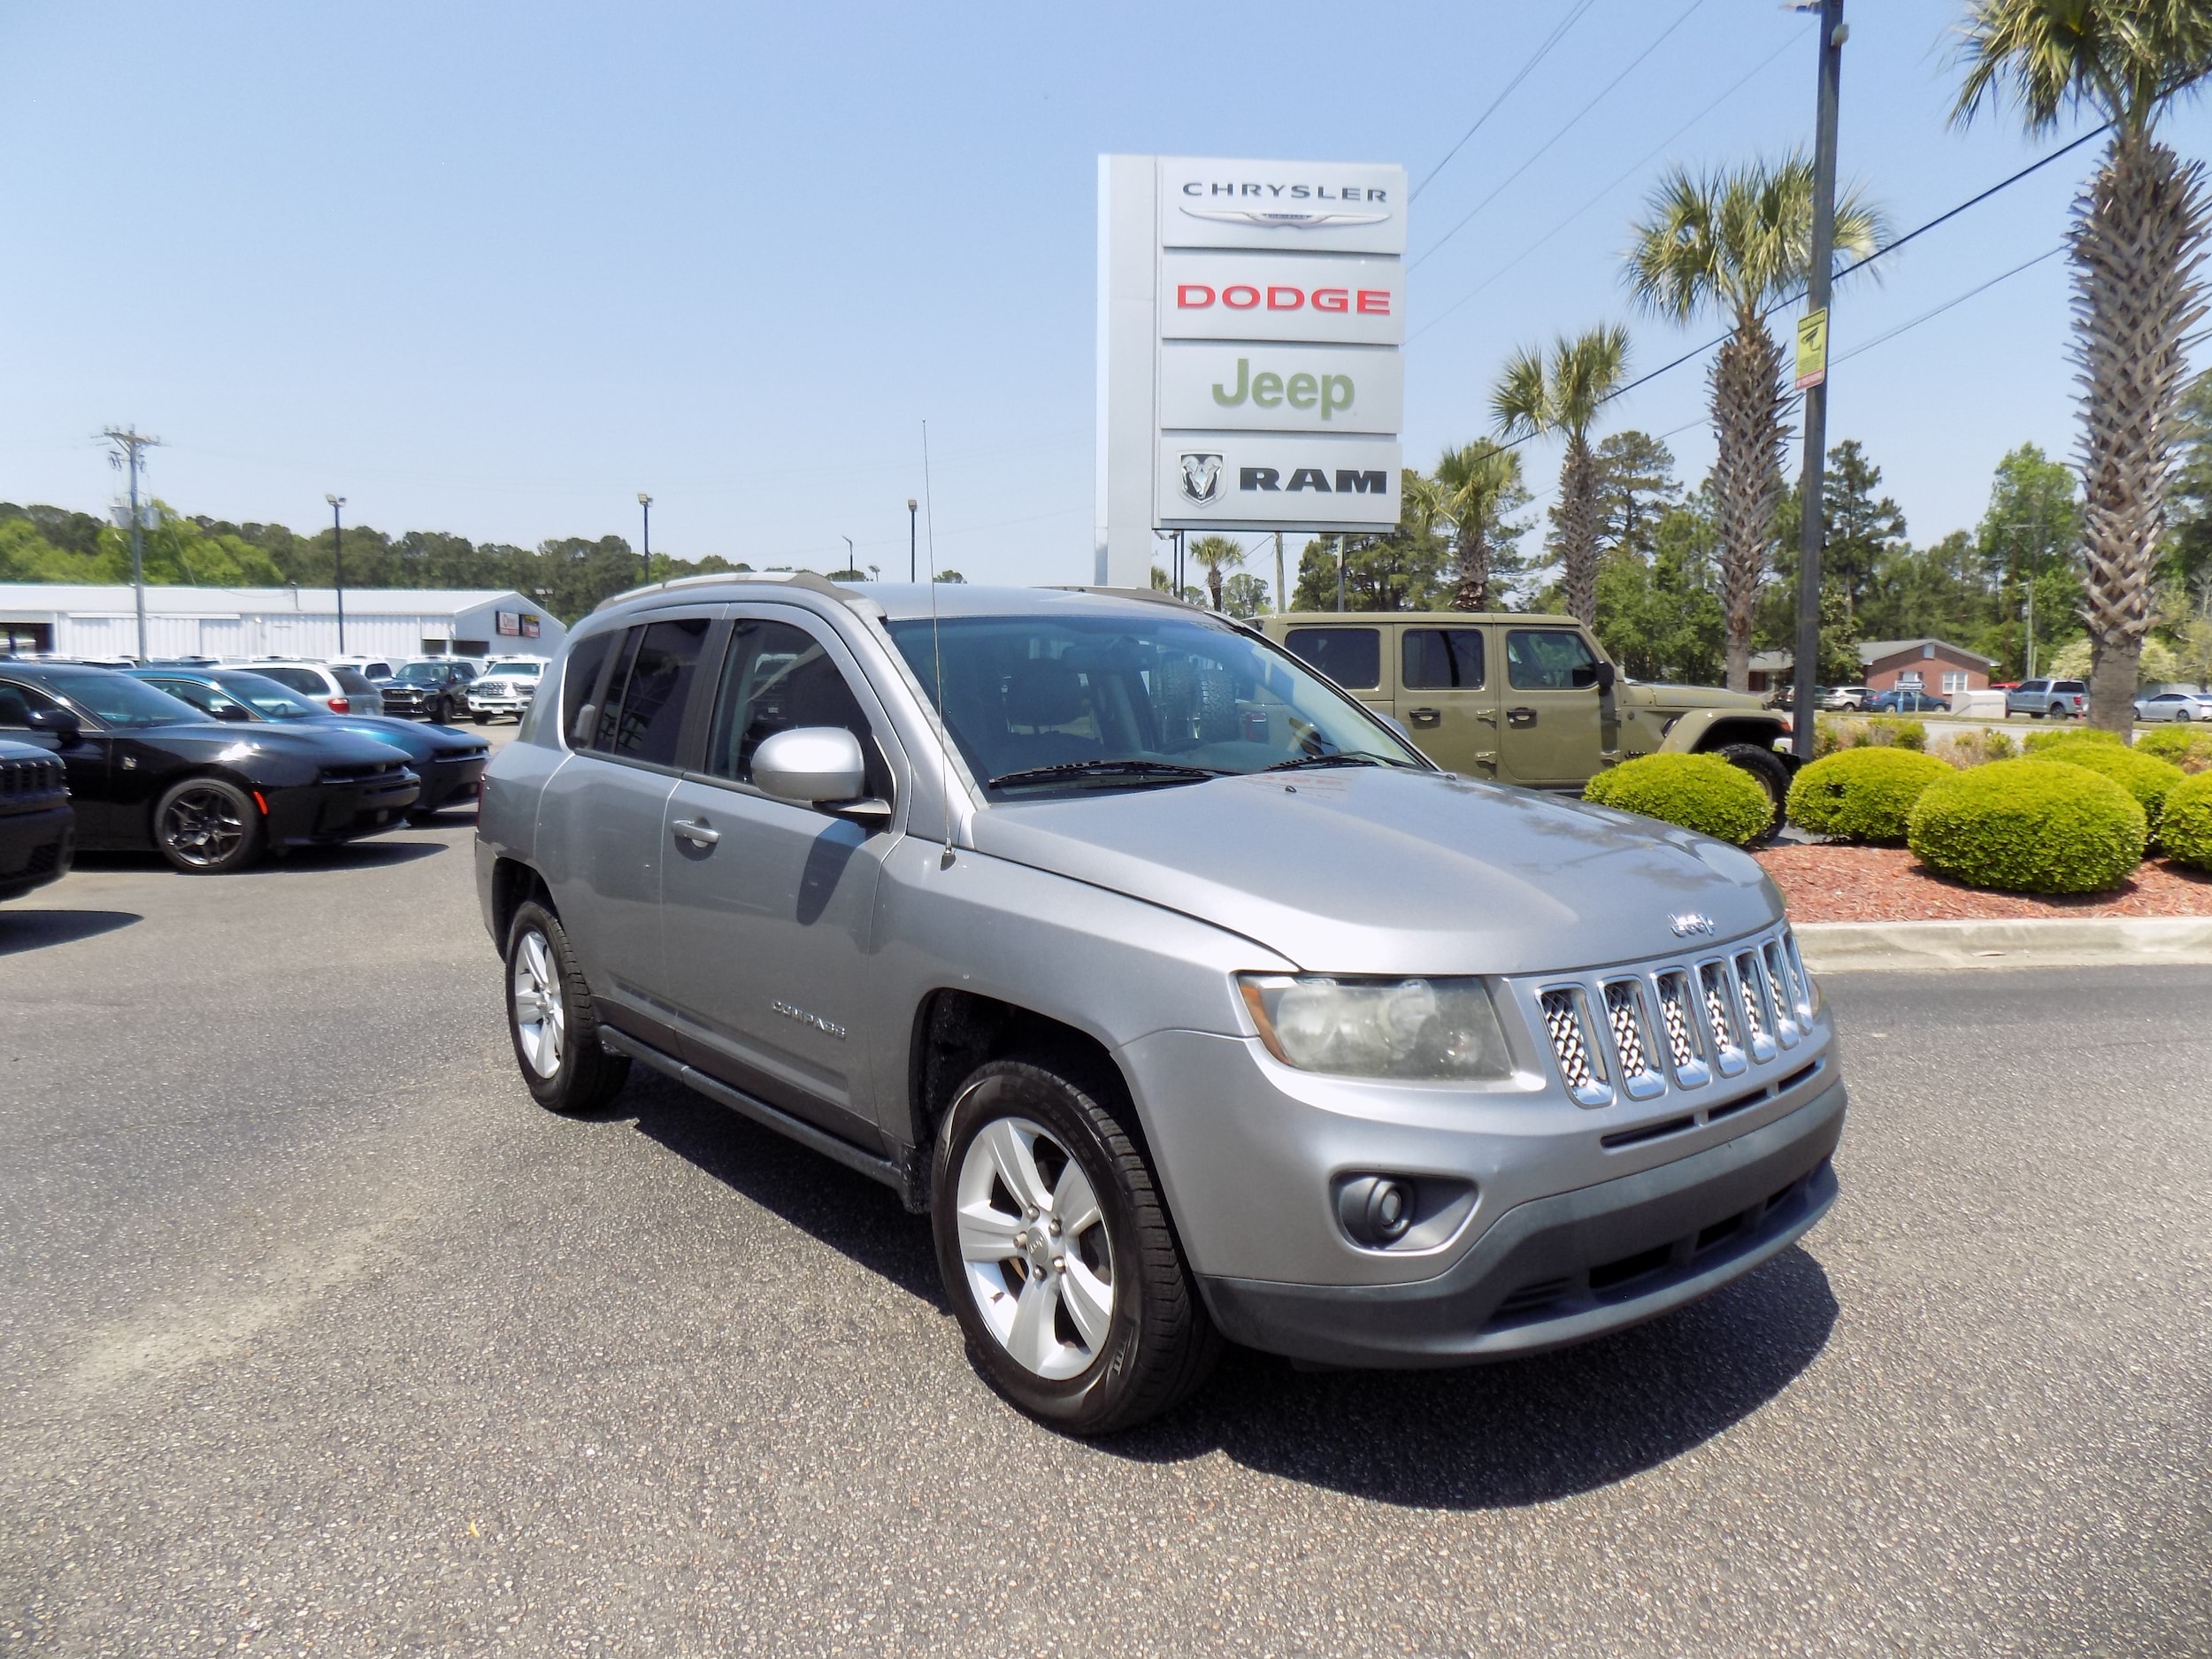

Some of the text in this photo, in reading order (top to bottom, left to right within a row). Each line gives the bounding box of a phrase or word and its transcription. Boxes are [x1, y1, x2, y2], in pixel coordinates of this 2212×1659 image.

[1182, 182, 1387, 203] CHRYSLER
[1177, 284, 1391, 316] DODGE
[1211, 358, 1356, 420] Jeep
[1240, 467, 1387, 494] RAM
[1668, 913, 1715, 938] Jeep
